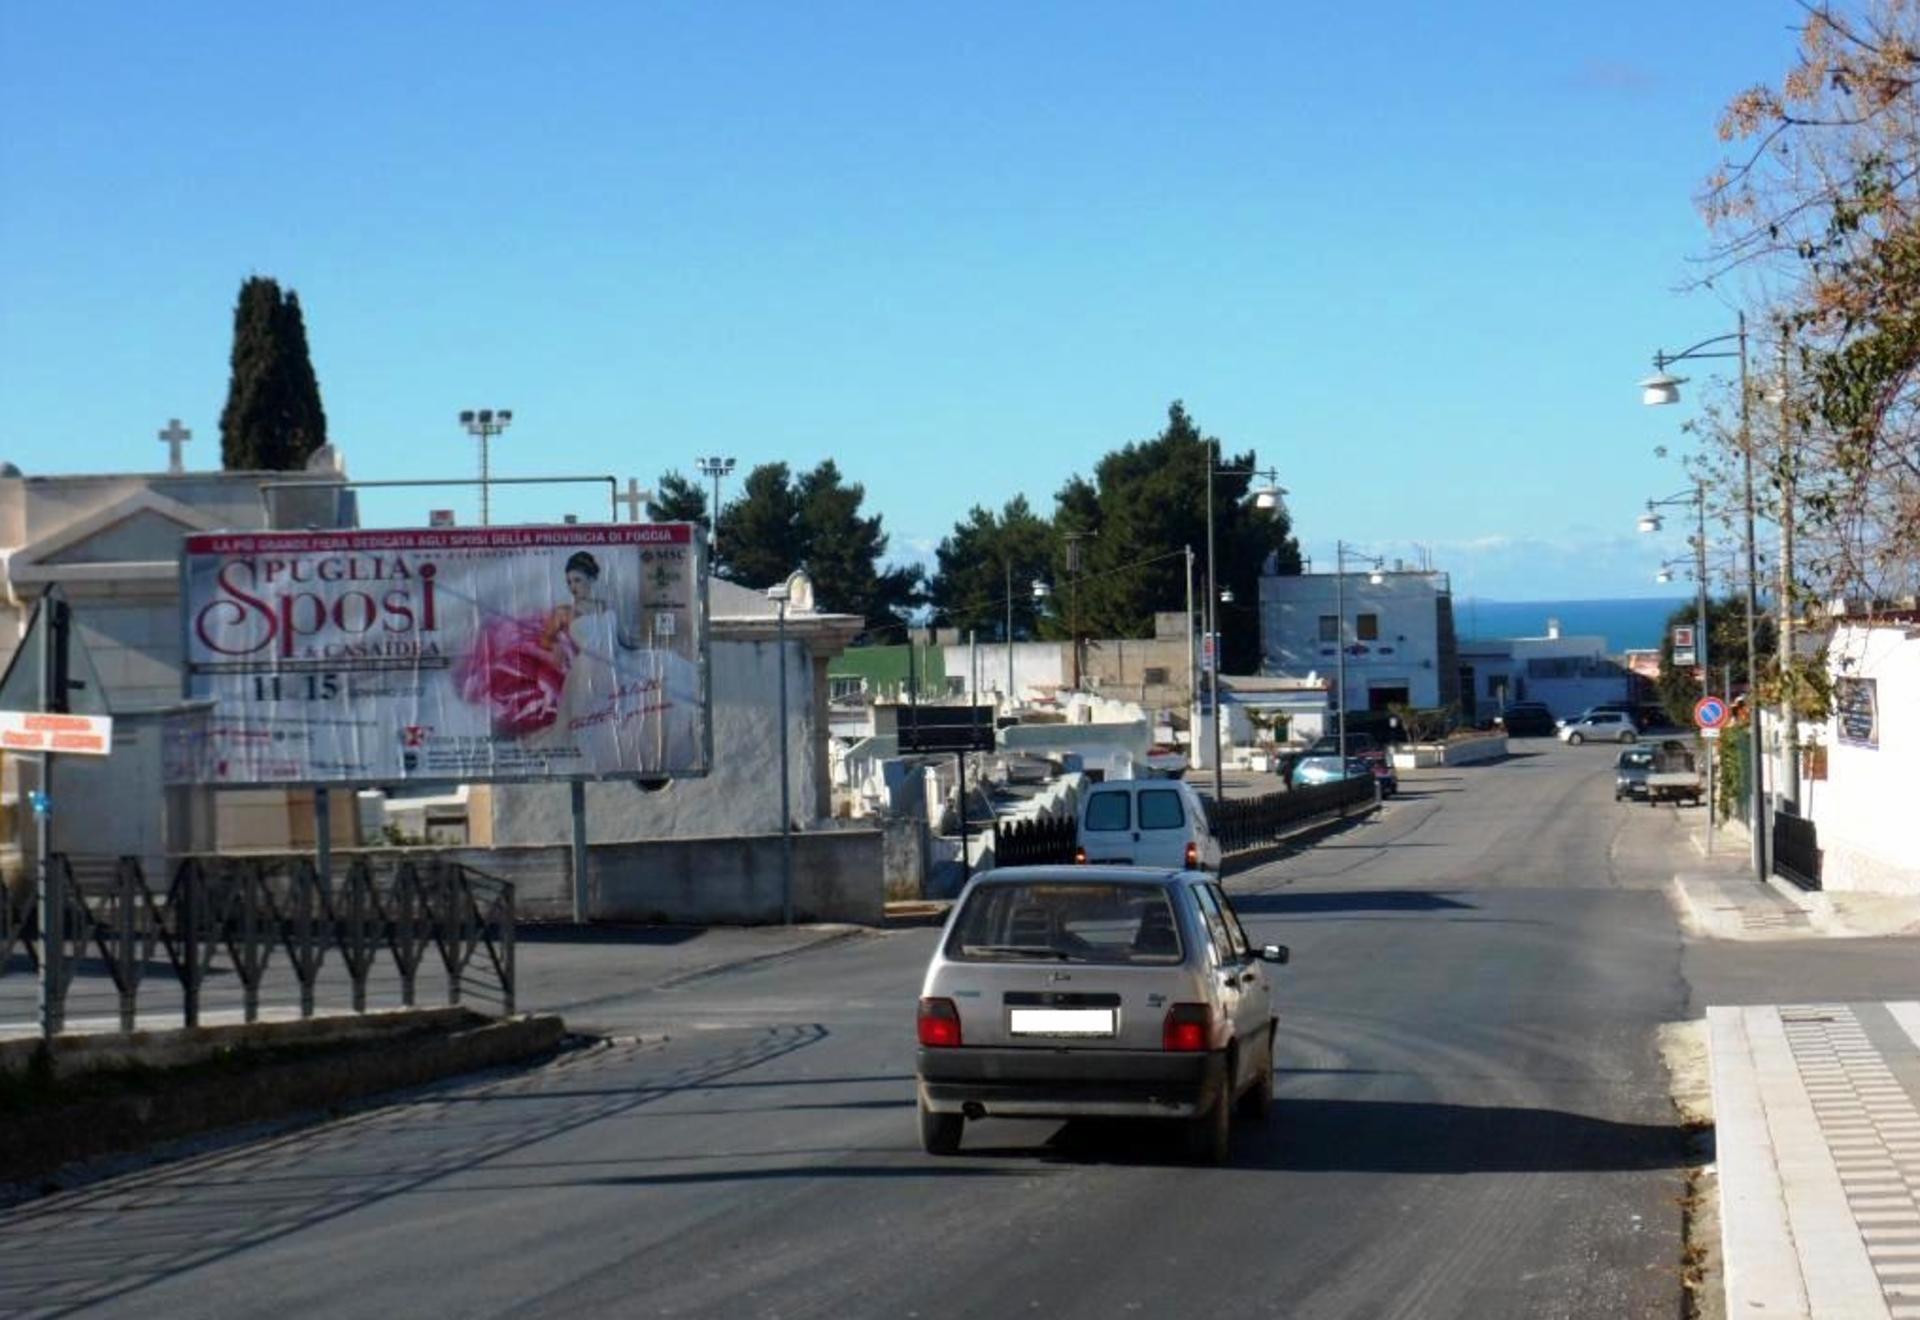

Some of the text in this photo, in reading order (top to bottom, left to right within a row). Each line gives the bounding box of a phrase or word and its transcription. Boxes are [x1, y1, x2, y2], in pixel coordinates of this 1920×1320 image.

[353, 535, 415, 549] DEDICATA
[418, 534, 448, 548] AGLI
[451, 534, 488, 547] SPOSI
[492, 533, 532, 546] DELLA
[535, 531, 605, 545] PROVINCIA
[608, 530, 623, 542] DI
[626, 529, 672, 542] FOGGIA
[262, 556, 412, 584] PUGLIA
[254, 676, 282, 701] 11
[306, 674, 338, 701] 15
